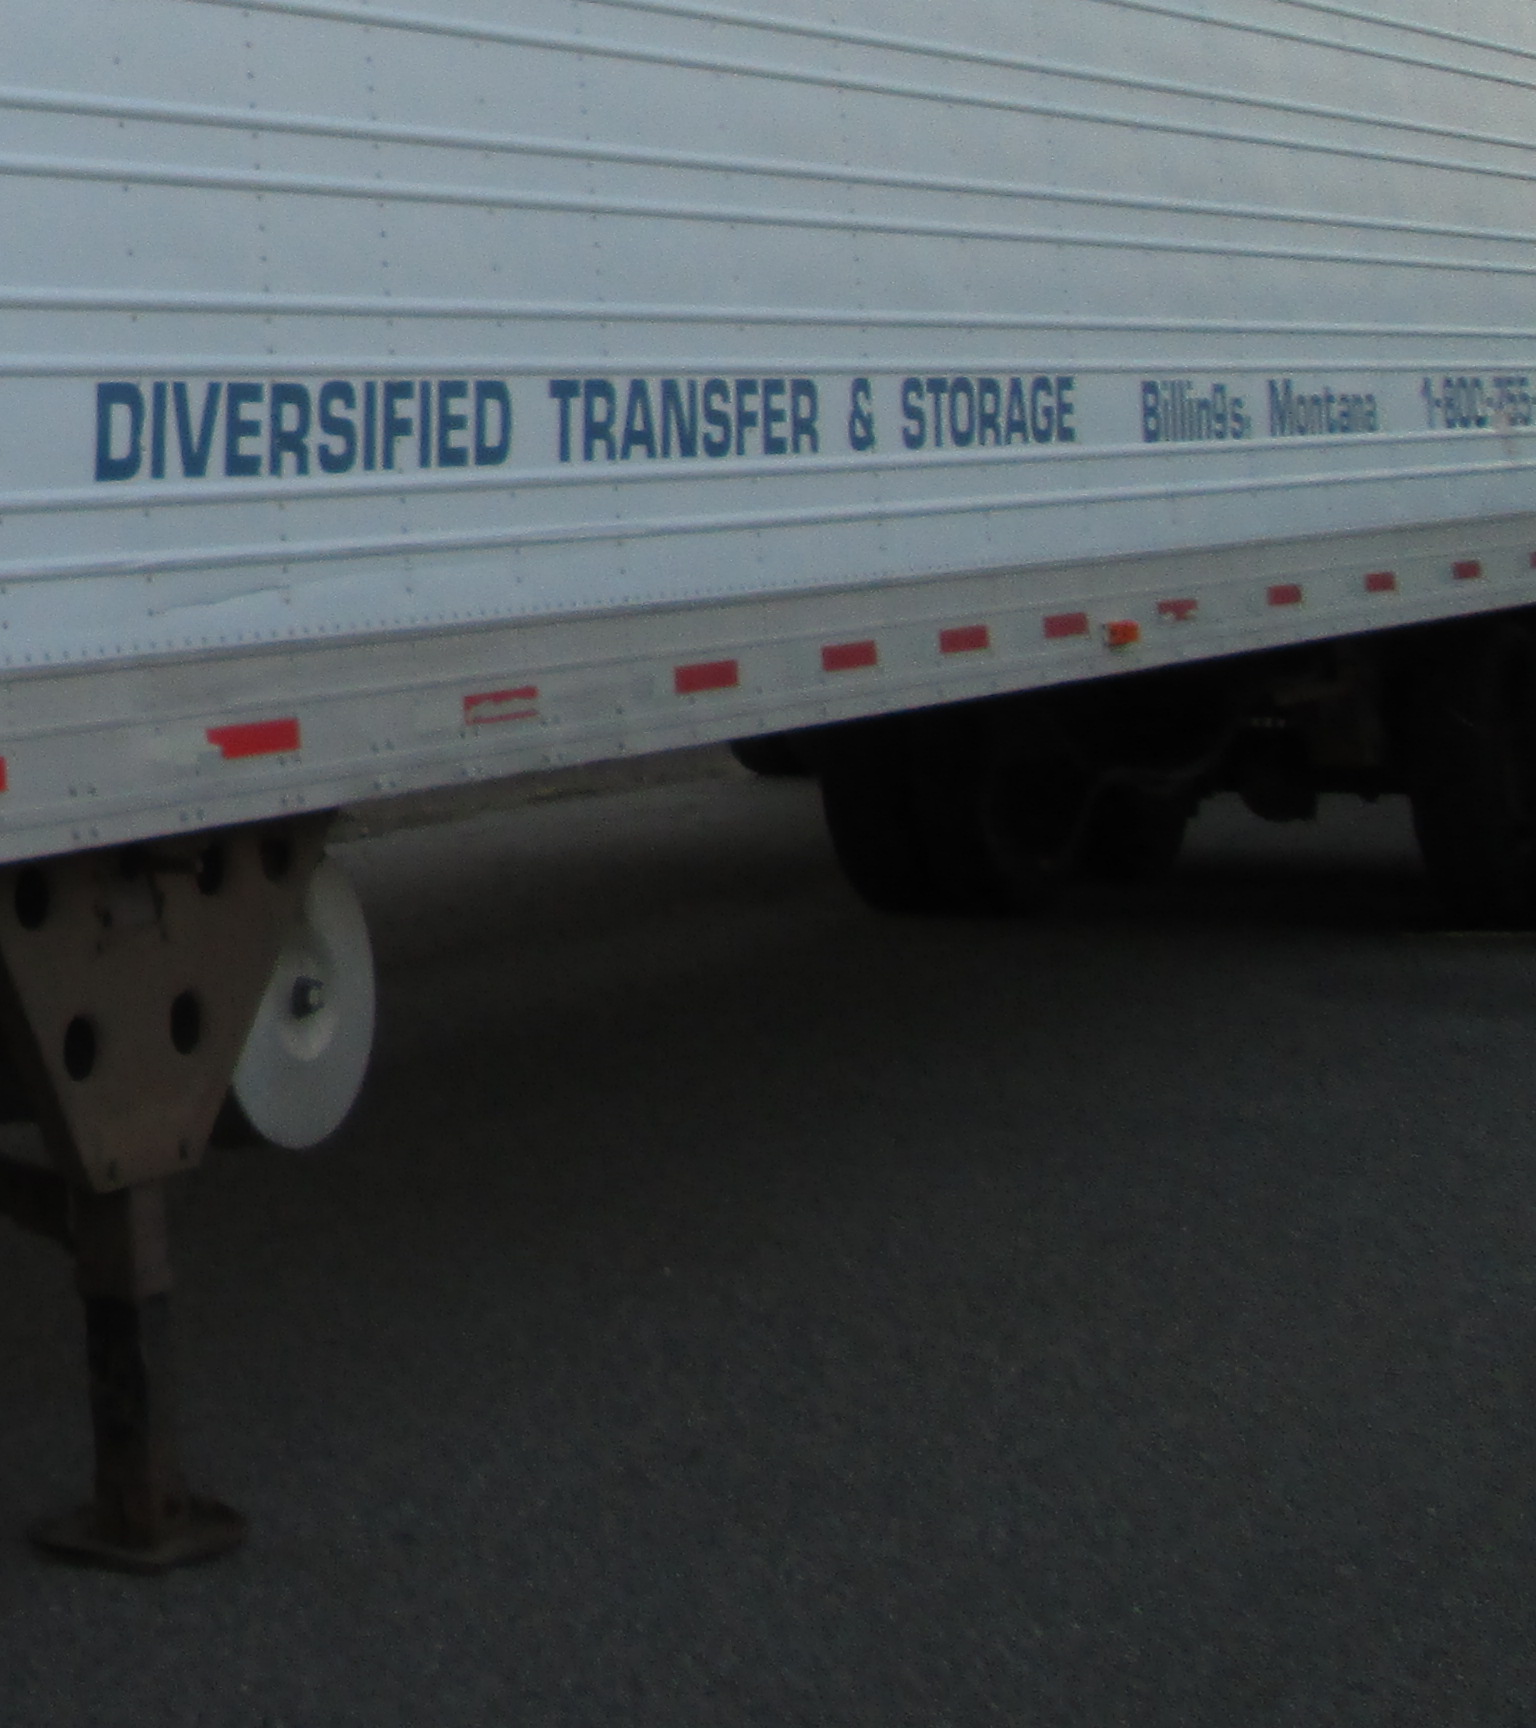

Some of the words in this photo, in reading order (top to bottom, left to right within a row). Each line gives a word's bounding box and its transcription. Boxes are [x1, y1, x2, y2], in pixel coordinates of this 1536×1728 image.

[94, 380, 513, 481] DIVERSIFIED
[549, 378, 820, 462] TRANSFER
[849, 377, 876, 451] &
[901, 376, 1076, 449] STORAGE
[1268, 378, 1377, 436] Montana
